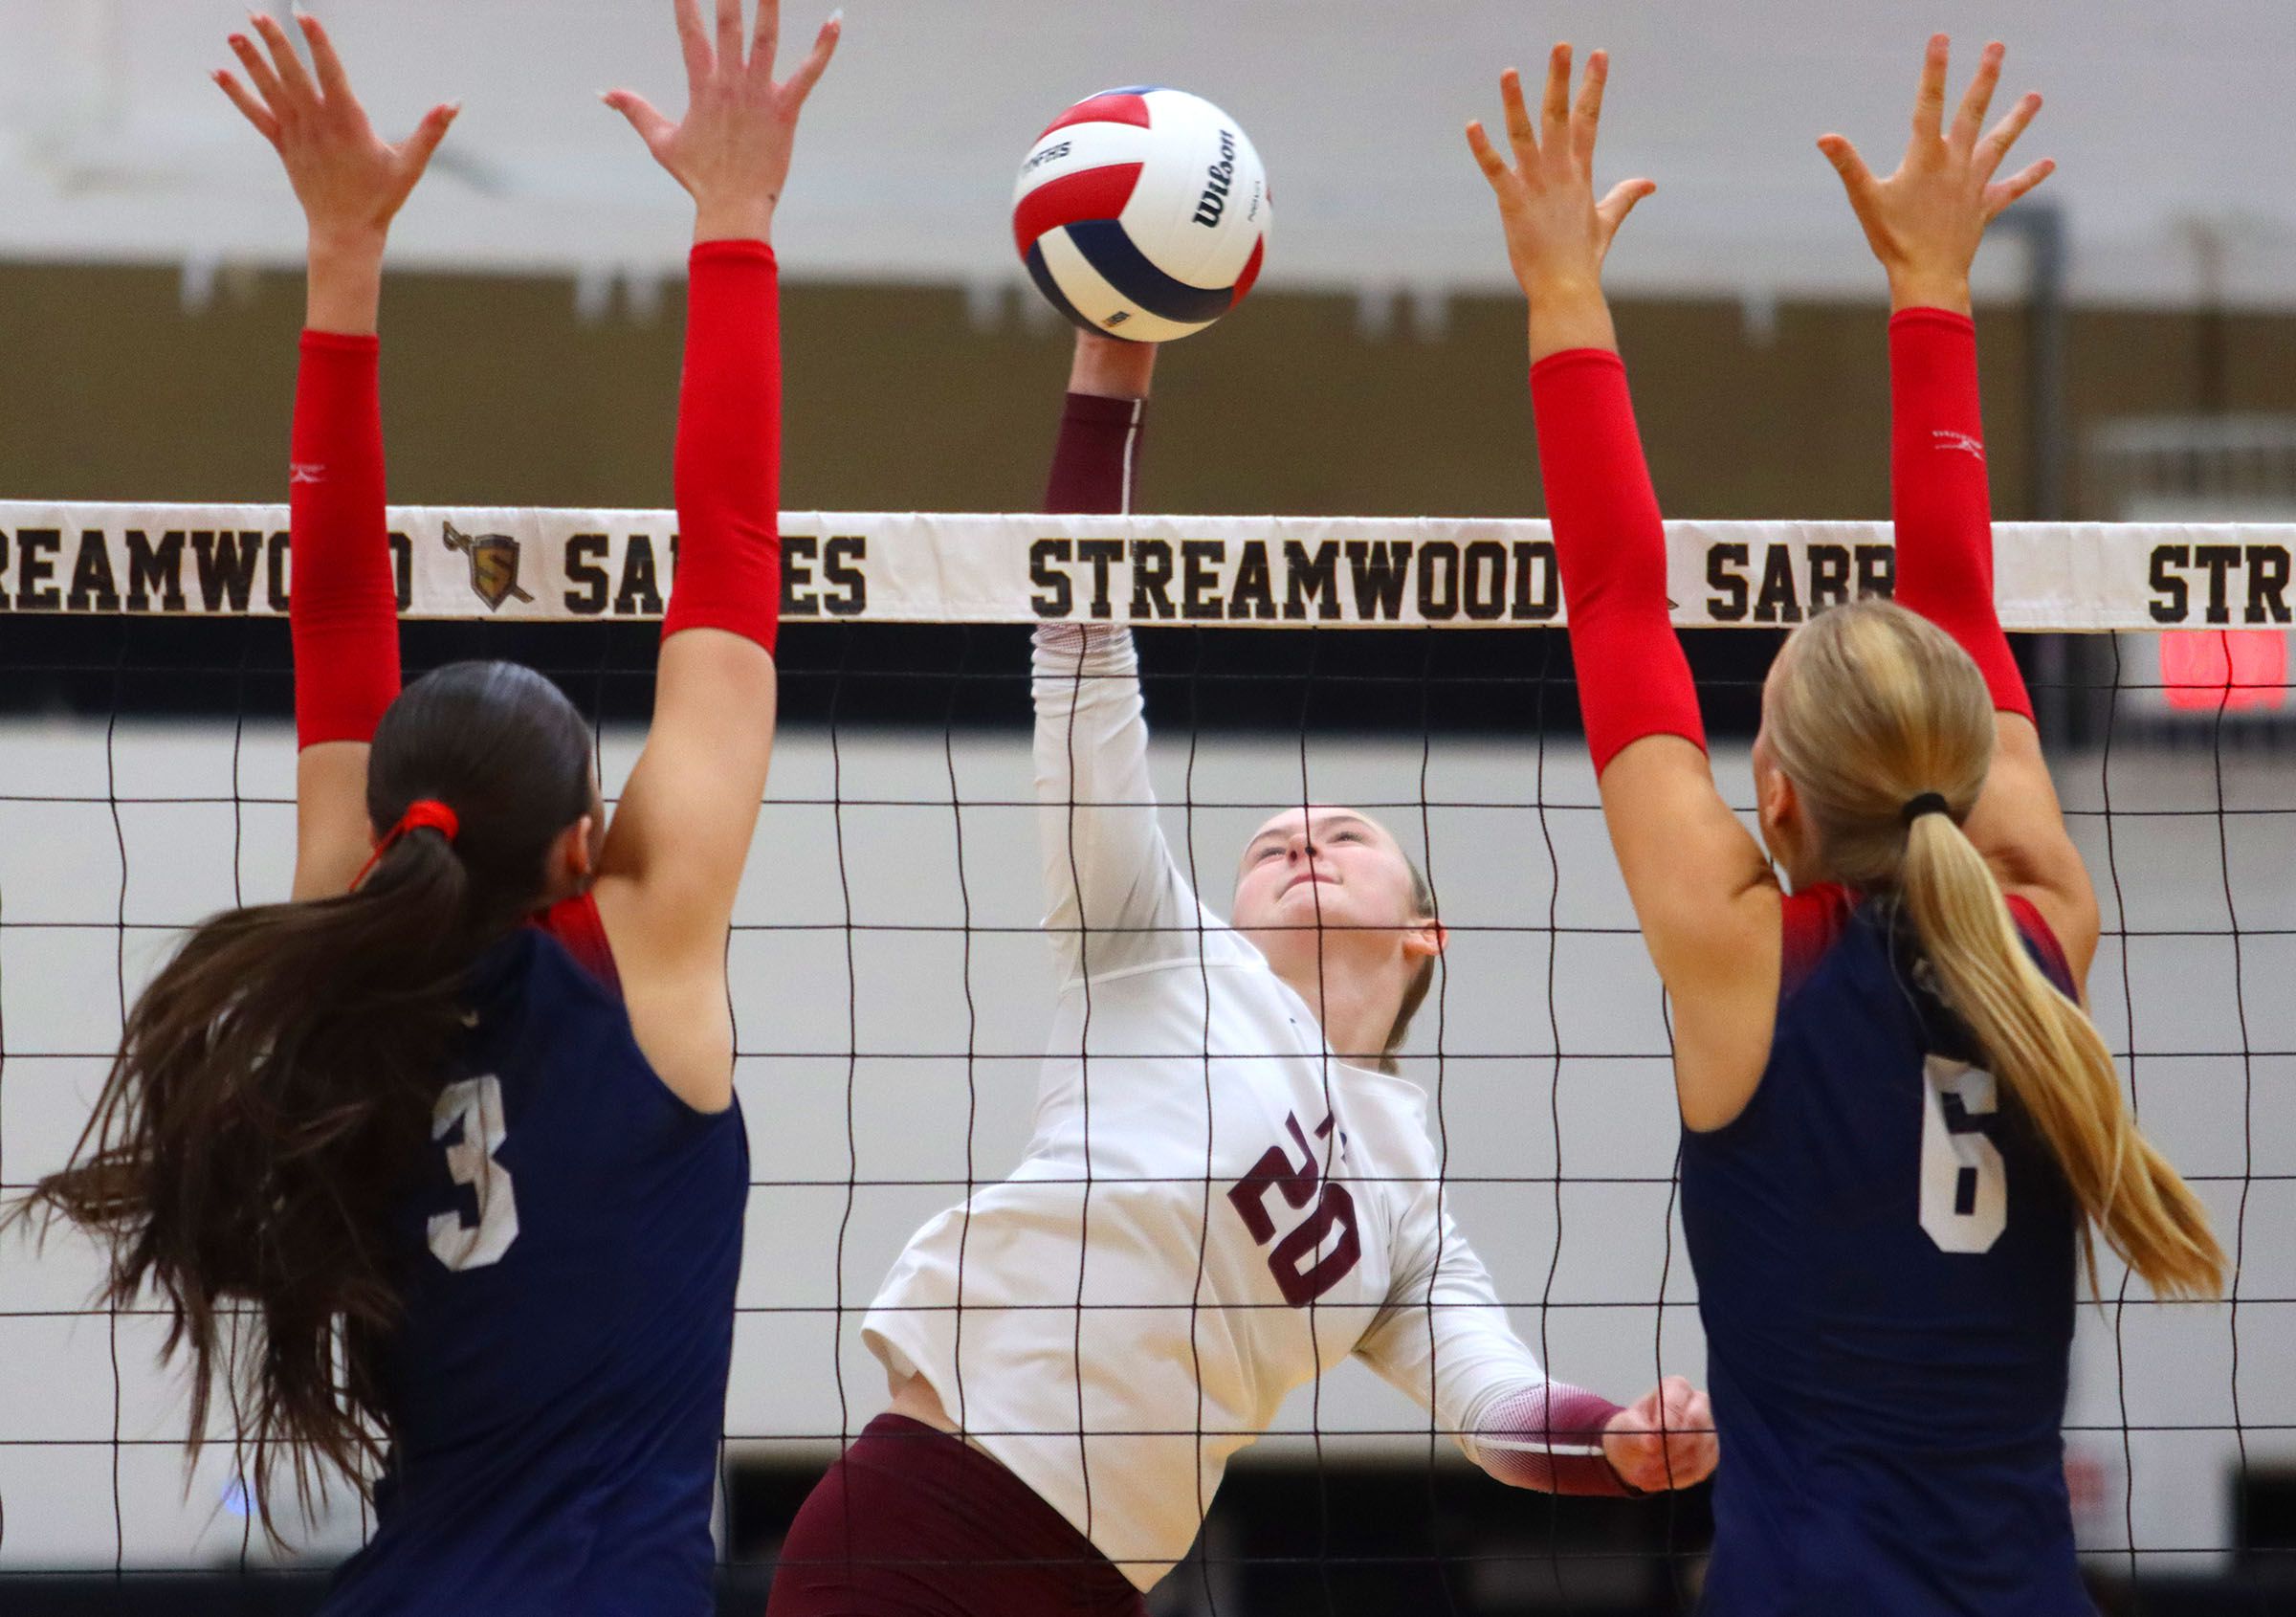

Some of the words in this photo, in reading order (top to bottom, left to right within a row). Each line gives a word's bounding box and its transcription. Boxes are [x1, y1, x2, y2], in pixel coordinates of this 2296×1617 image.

[1190, 128, 1236, 229] Wilson
[563, 534, 867, 616] SAES
[1028, 539, 1560, 621] STREAMWOOD
[2148, 543, 2292, 625] STR
[427, 1073, 519, 1272] 3
[1226, 1110, 1362, 1309] 20
[1918, 1053, 2007, 1254] 6
